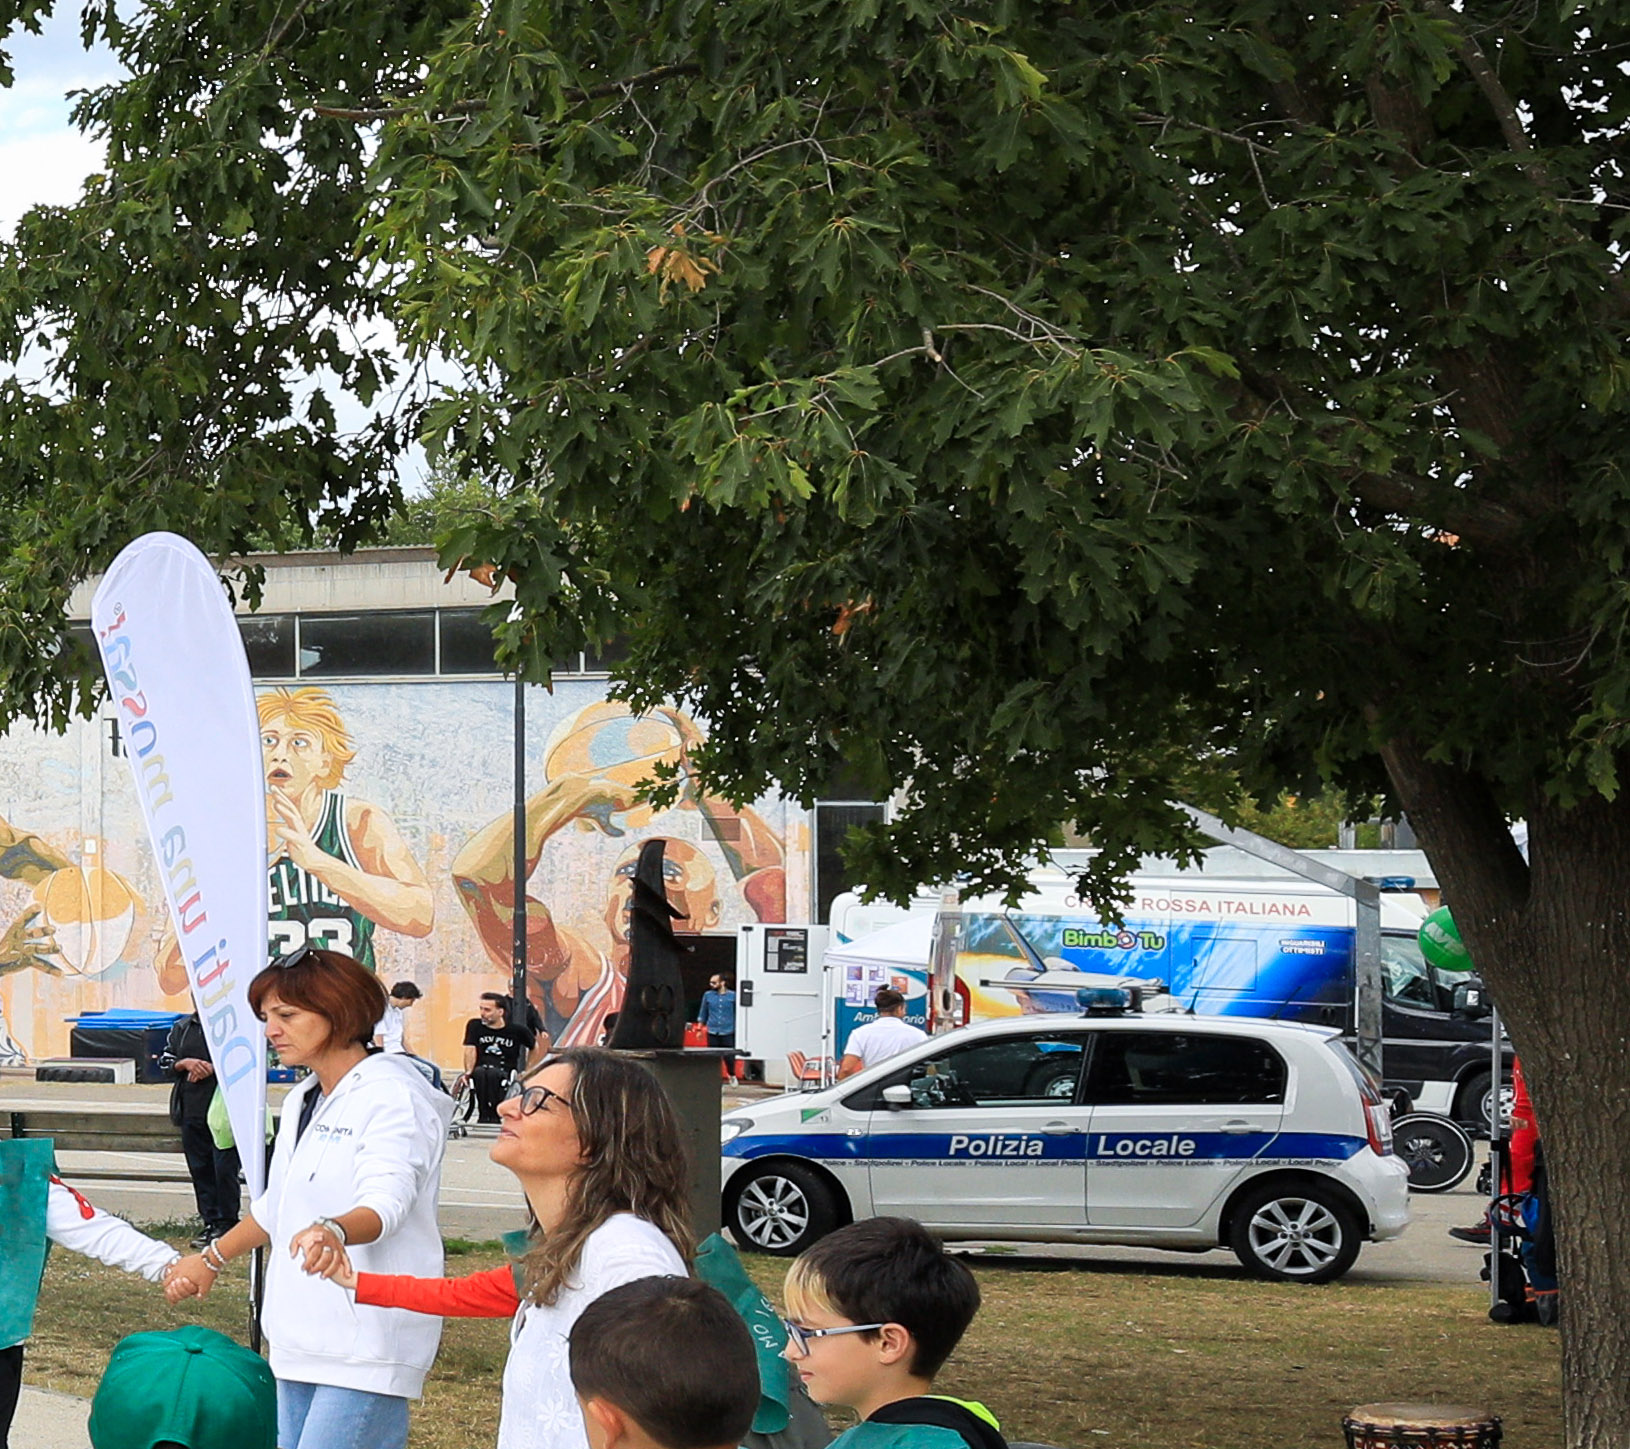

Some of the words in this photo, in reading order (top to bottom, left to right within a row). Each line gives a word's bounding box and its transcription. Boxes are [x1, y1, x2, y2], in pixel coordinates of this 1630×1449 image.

[1142, 898, 1211, 913] ROSSA
[1218, 900, 1311, 917] ITALIANA
[1139, 932, 1165, 950] Tu
[948, 1135, 1045, 1156] Polizia
[1097, 1135, 1197, 1156] Locale
